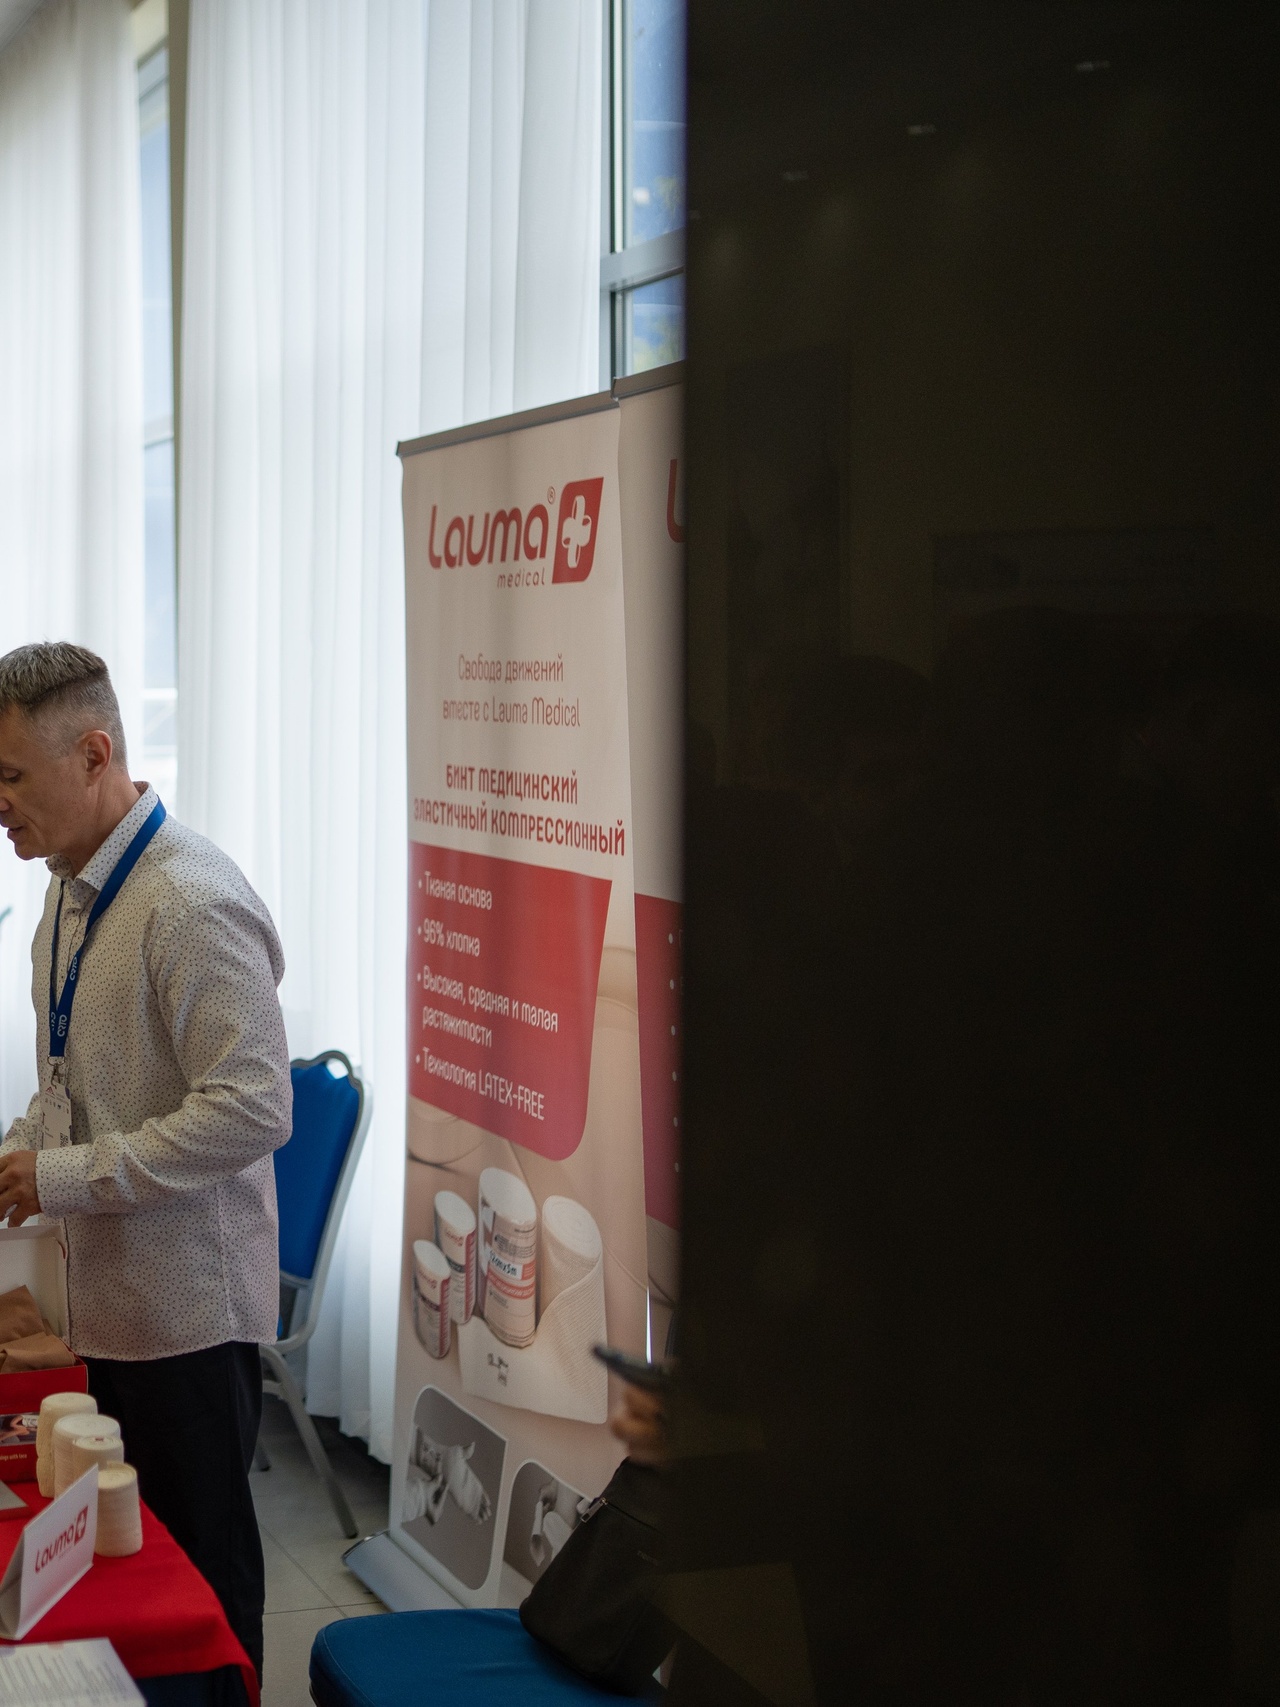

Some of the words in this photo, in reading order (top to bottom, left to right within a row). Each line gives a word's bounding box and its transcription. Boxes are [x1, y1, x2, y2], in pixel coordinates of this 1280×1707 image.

[428, 504, 549, 569] Lauma
[497, 567, 545, 589] medical
[458, 653, 502, 682] Свобода
[505, 653, 564, 683] движений
[443, 700, 480, 722] вместе
[483, 703, 489, 722] с
[492, 696, 528, 724] Lauma
[531, 697, 581, 727] Medical
[446, 764, 475, 791] БИНТ
[478, 768, 578, 805] МЕДИЦИНСКИЙ
[414, 797, 488, 833] ЭЛАСТИЧНЫЙ
[491, 806, 625, 856] КОМПРЕССИОННЫЙ
[424, 871, 456, 901] Тканая
[458, 884, 493, 910] основа
[423, 918, 444, 947] 96%
[446, 931, 480, 957] хлопка
[423, 965, 466, 1006] Высокая,
[469, 985, 509, 1017] средняя
[512, 1000, 518, 1020] и
[521, 1002, 558, 1033] малая
[423, 1006, 492, 1048] растяжимости
[422, 1046, 477, 1092] Технология
[478, 1069, 545, 1121] LATEX-FREE
[35, 1528, 75, 1573] Lauma
